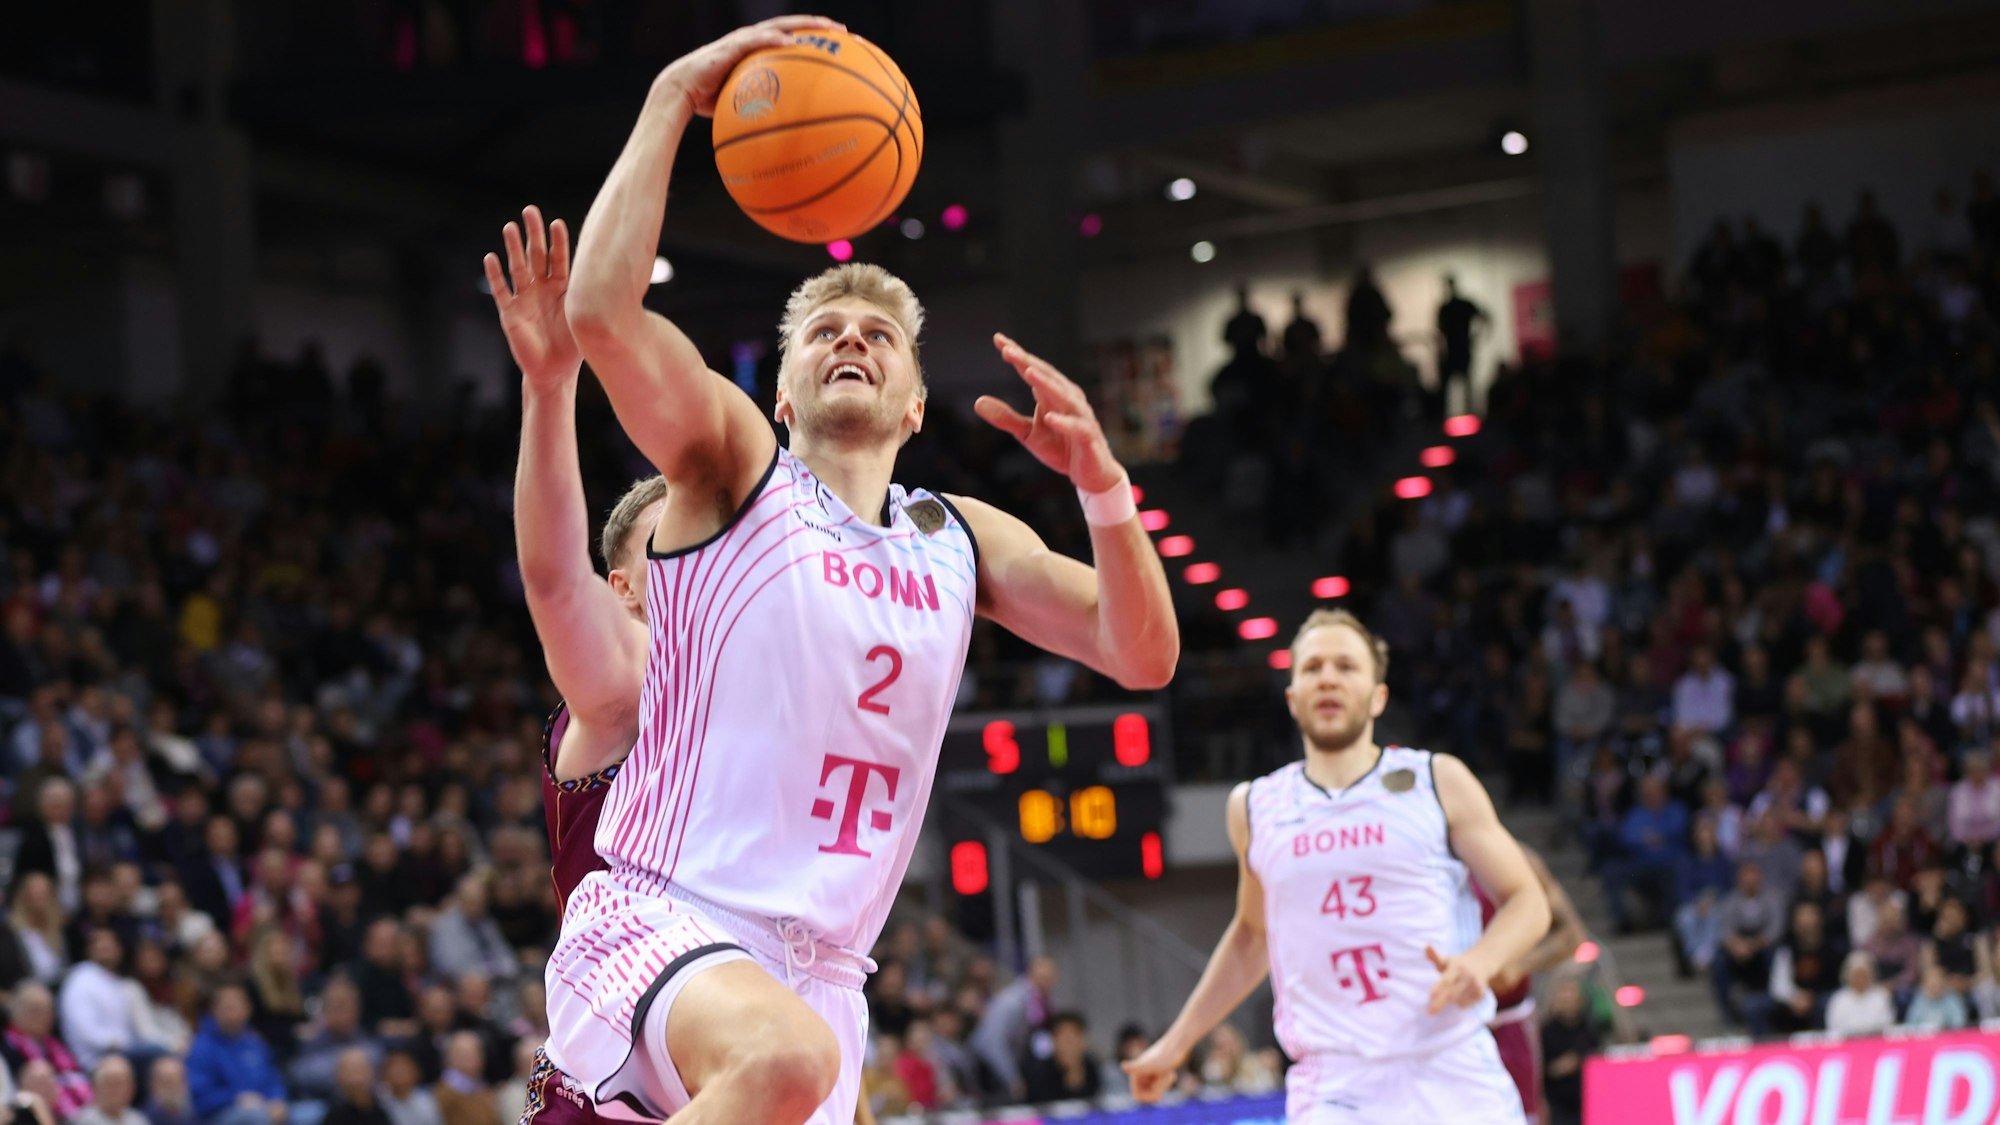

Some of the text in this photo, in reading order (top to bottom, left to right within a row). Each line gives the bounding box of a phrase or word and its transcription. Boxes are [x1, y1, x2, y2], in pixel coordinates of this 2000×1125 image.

[822, 549, 941, 612] BONN
[857, 644, 903, 716] 2
[983, 719, 1021, 775] 5
[811, 752, 901, 859] T
[1292, 823, 1385, 858] BONN
[1320, 875, 1378, 920] 43
[1330, 943, 1391, 1006] T
[1668, 1046, 2000, 1125] VOLLD
